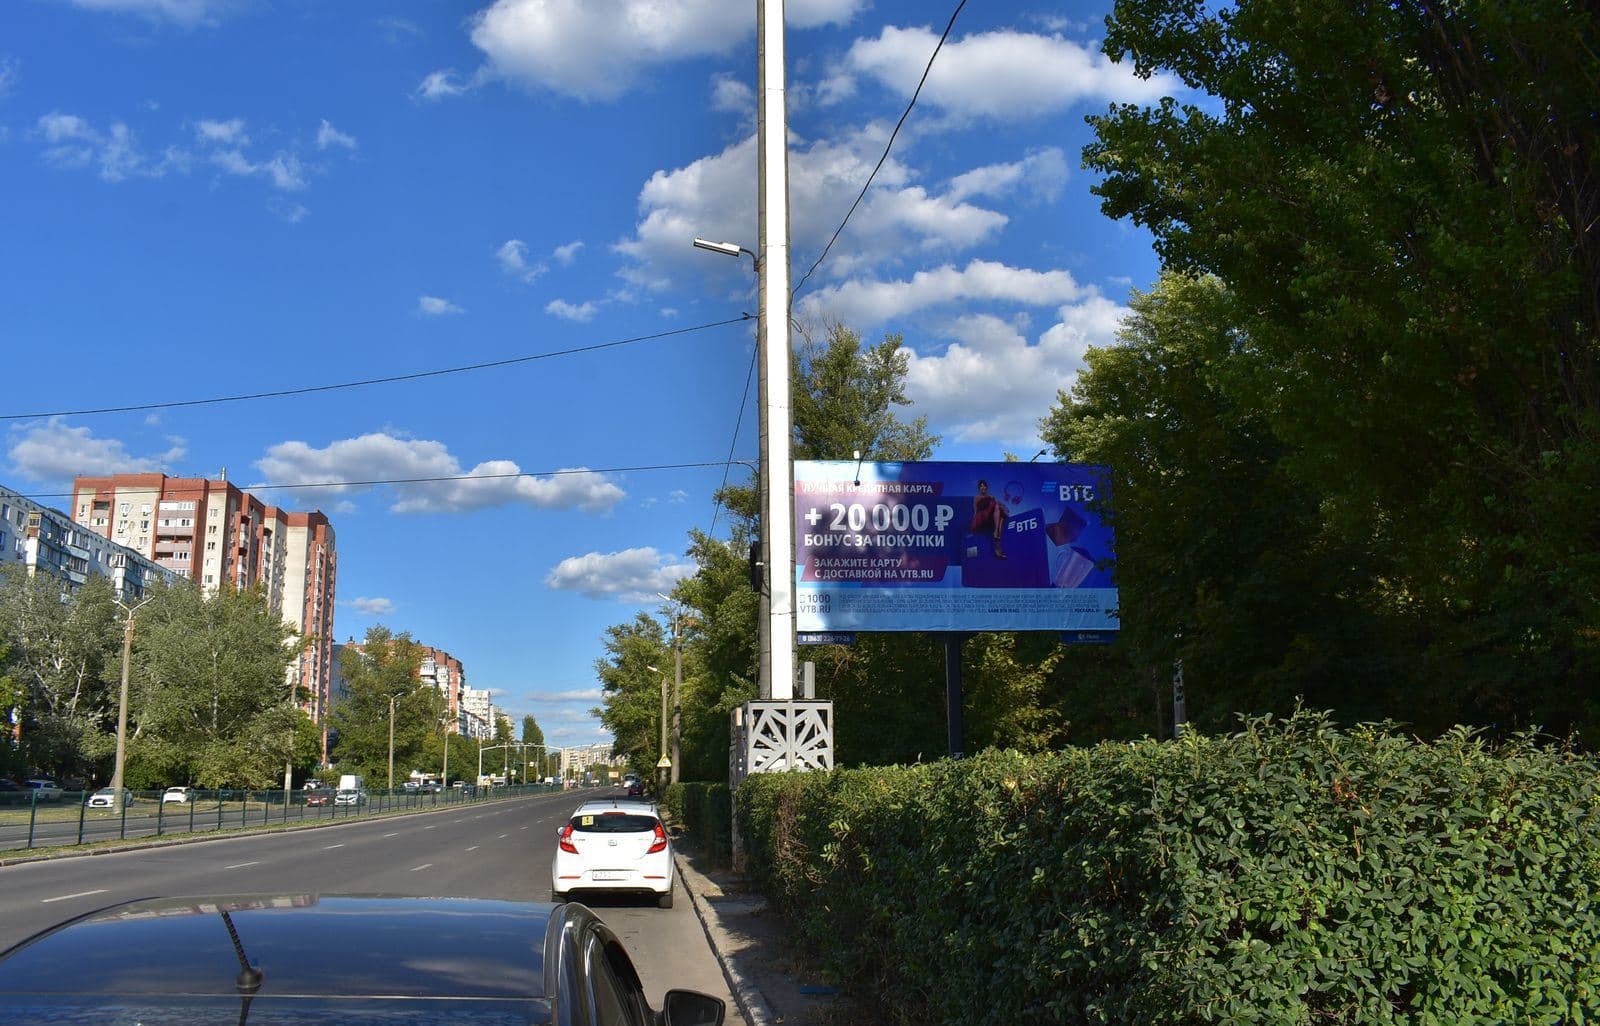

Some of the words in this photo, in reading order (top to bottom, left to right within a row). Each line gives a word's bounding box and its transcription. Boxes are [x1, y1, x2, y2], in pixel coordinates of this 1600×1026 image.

[904, 485, 933, 493] КАРТА
[1016, 518, 1037, 532] ВТБ
[805, 534, 851, 547] БОНУС
[855, 535, 872, 547] ЗА
[877, 535, 944, 547] ПОКУПКИ
[815, 558, 867, 567] ЗАКАЖИТЕ
[871, 559, 902, 567] КАРТУ
[815, 569, 820, 578] С
[823, 569, 881, 579] ДОСТАВКОЙ
[884, 570, 897, 578] НА
[900, 570, 933, 578] VTB.RU
[808, 594, 830, 603] 1000
[800, 605, 830, 613] VTB.RU
